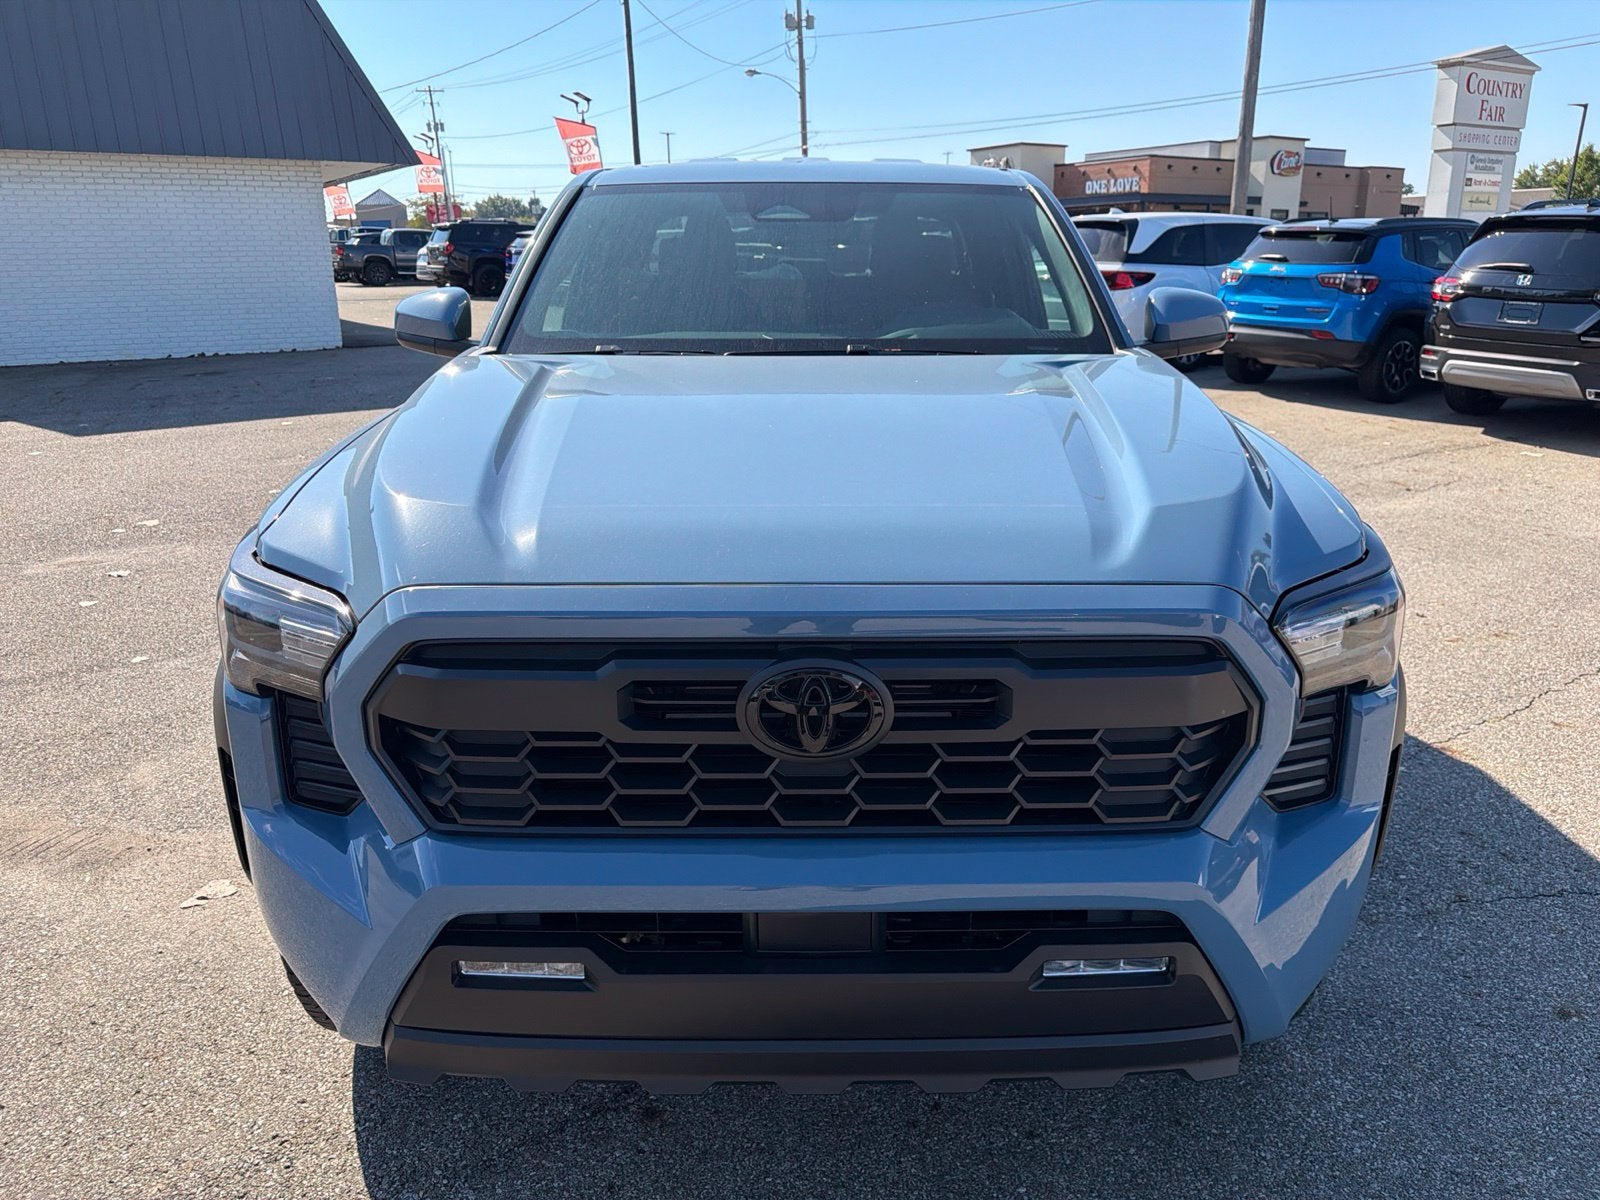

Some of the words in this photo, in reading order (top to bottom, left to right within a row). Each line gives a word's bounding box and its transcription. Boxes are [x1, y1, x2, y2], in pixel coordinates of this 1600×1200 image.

[1465, 71, 1526, 100] COUNTRY
[1478, 99, 1506, 123] FAIR
[1458, 132, 1490, 145] SHOPPING
[1493, 134, 1519, 146] CENTER
[1085, 180, 1107, 194] ONE
[1109, 176, 1140, 193] LOVE
